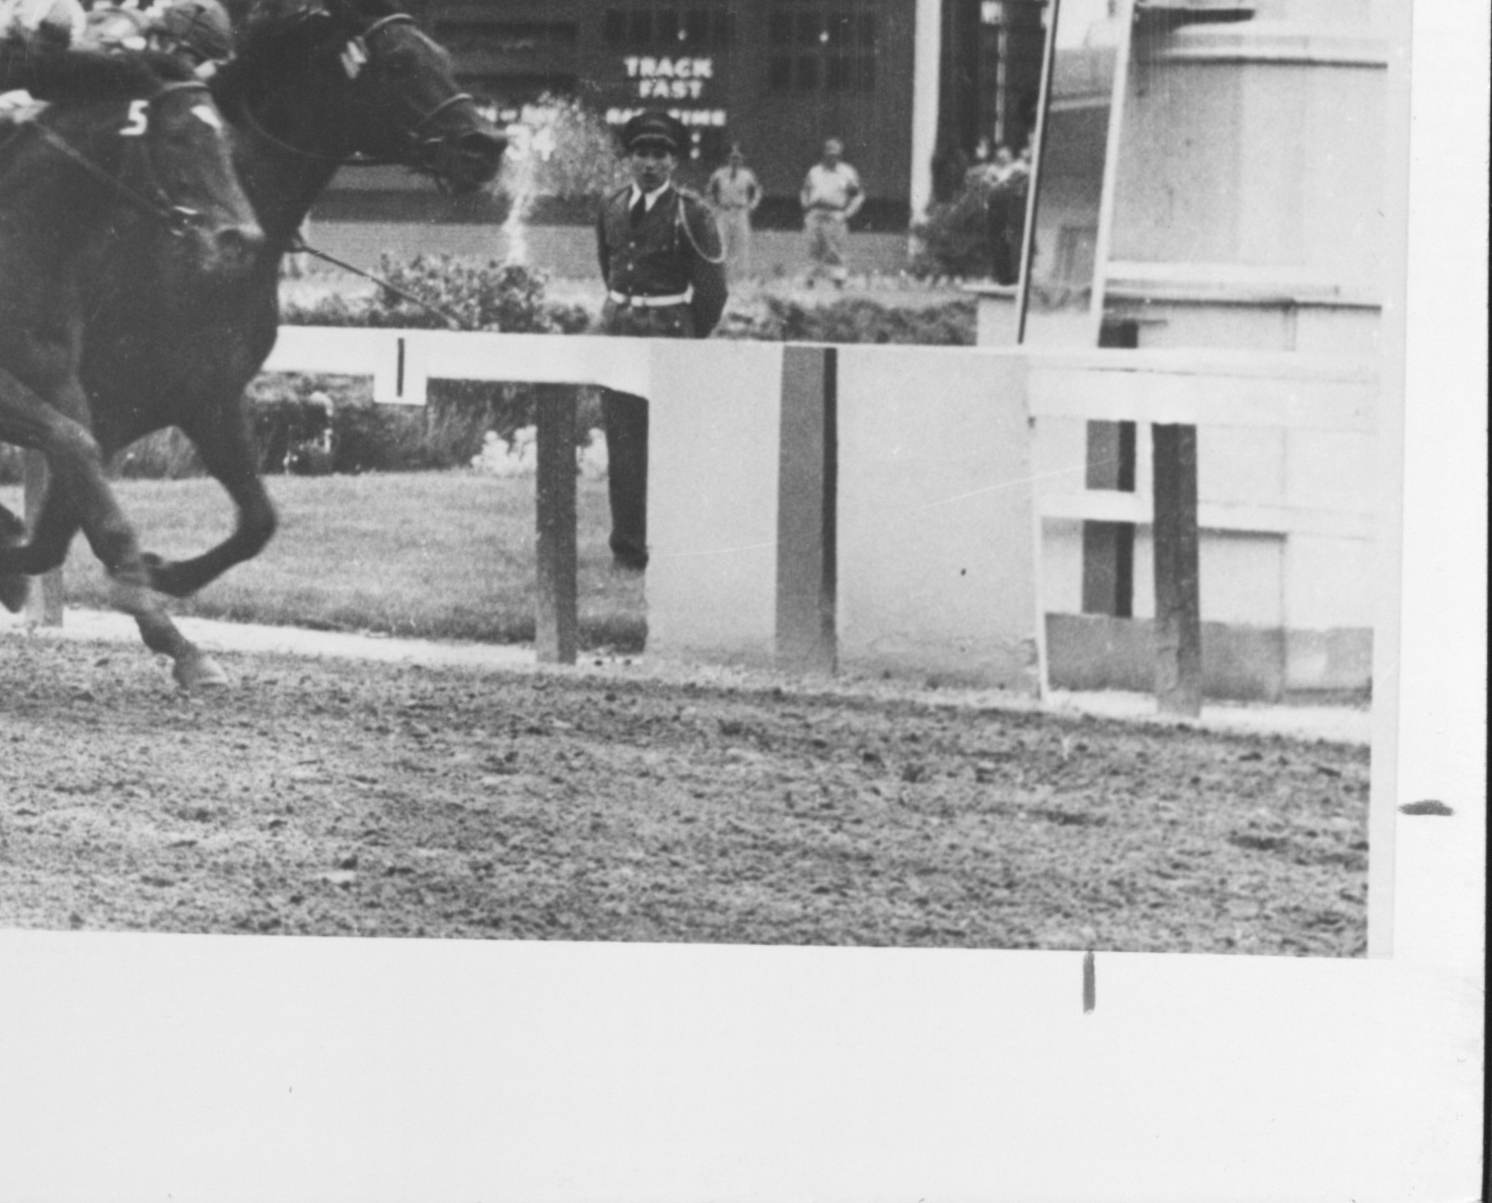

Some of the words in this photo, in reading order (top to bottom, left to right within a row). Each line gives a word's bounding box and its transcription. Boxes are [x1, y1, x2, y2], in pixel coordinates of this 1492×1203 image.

[623, 55, 714, 79] TRACK
[638, 78, 704, 100] FAST
[119, 99, 150, 136] 5
